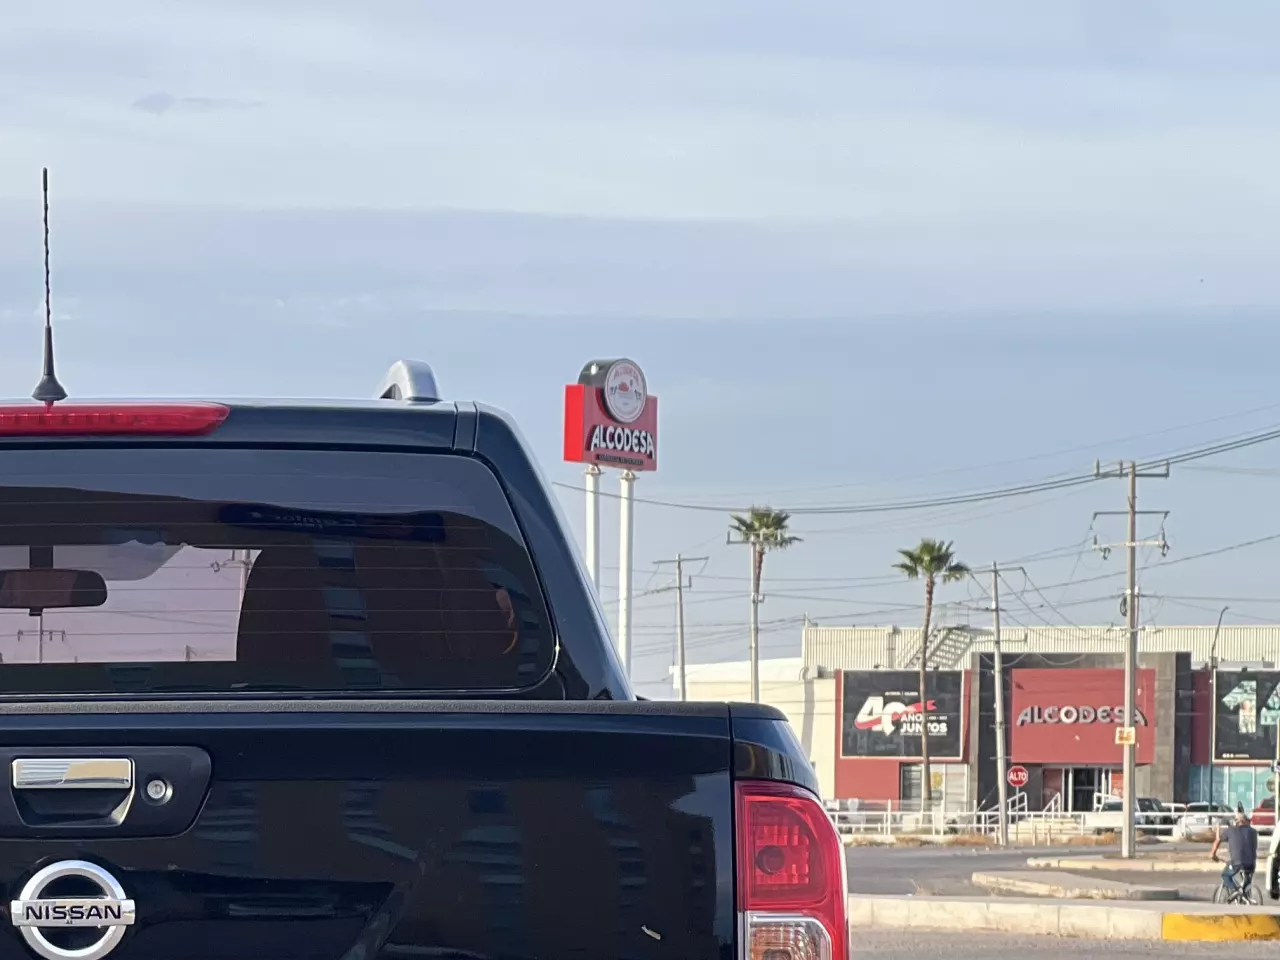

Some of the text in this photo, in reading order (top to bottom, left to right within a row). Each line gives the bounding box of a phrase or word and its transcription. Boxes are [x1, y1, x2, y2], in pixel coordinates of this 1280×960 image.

[590, 423, 656, 460] ALCODESA
[1016, 704, 1148, 727] ALCODESA
[1008, 771, 1027, 781] ALTO
[25, 905, 122, 920] NISSAN
